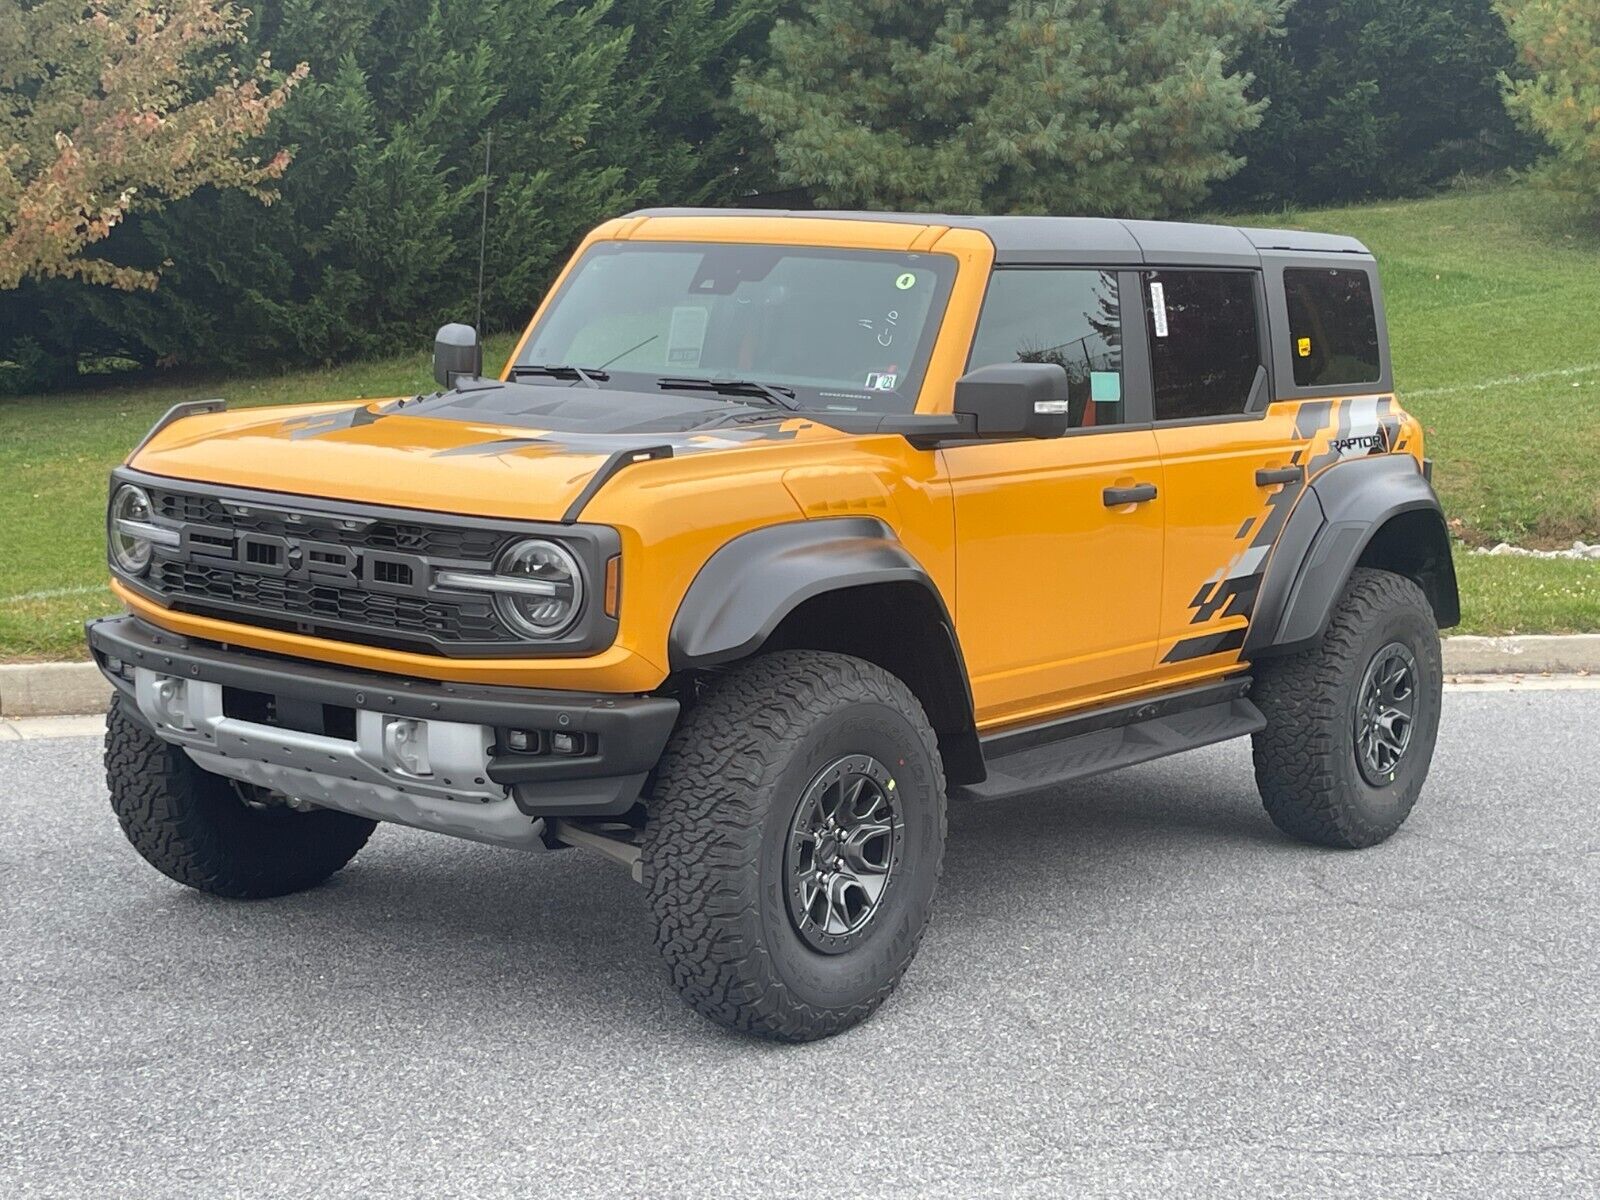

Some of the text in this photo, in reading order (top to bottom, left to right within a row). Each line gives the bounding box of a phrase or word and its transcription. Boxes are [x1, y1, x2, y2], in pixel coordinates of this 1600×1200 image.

[877, 310, 899, 346] C-10
[1329, 434, 1386, 455] RAPTOR
[181, 523, 429, 597] FORD
